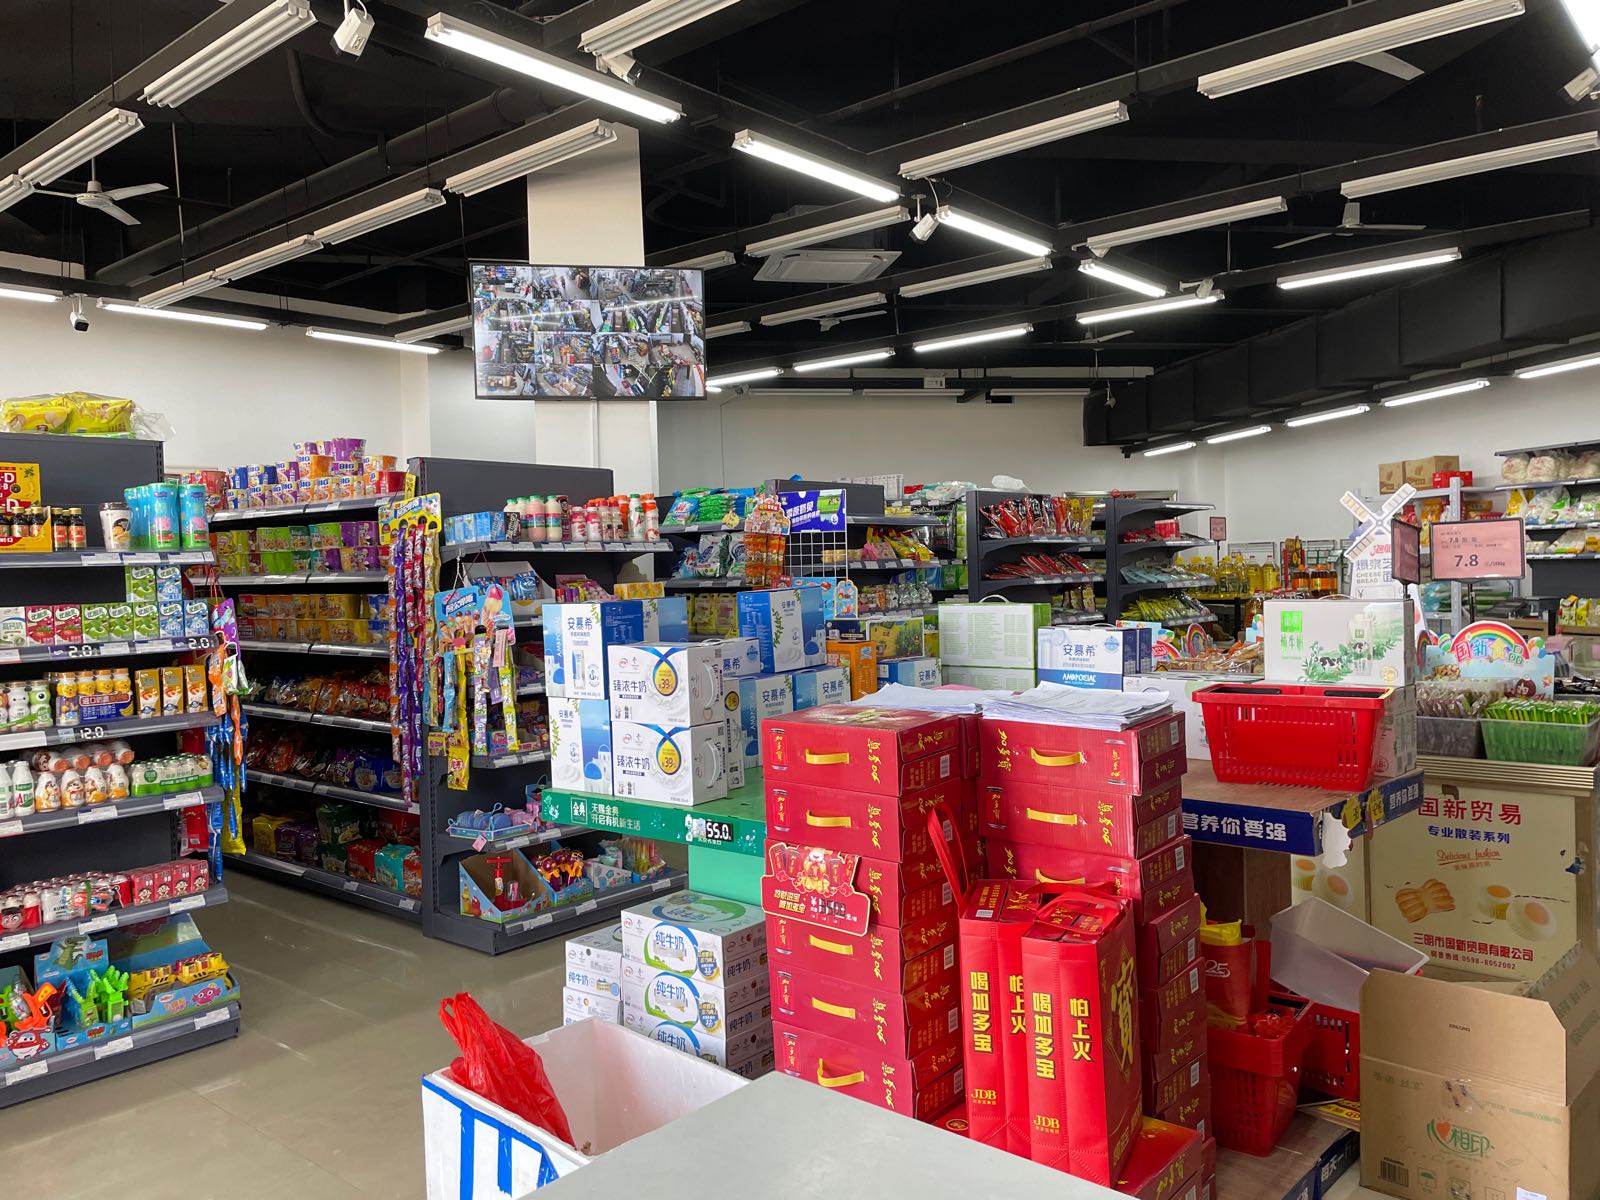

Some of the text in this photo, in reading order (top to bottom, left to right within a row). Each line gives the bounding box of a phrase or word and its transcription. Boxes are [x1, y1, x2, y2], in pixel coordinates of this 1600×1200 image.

[1454, 554, 1478, 567] 7.8
[567, 616, 593, 630] 安慕希
[68, 645, 93, 658] 2.0
[189, 637, 210, 650] 2.0
[1063, 644, 1096, 657] 安慕希
[722, 657, 741, 671] 慕希
[762, 687, 787, 703] 安慕希
[822, 680, 845, 694] 安慕希
[80, 727, 104, 740] 12.0
[573, 802, 586, 817] 金典
[591, 802, 619, 816] 天赐金典
[1418, 797, 1522, 826] 国新贸易
[591, 814, 641, 831] 开启有机新生活
[1182, 812, 1288, 842] 营养你要强
[706, 823, 731, 840] 55.0
[1427, 825, 1511, 844] 专业散装系列
[1437, 849, 1471, 863] Delicious
[655, 931, 685, 951] 纯牛奶
[1413, 932, 1534, 962] 三明市国新贸易有限公司
[568, 971, 589, 987] 纯牛奶
[656, 980, 686, 1000] 纯牛奶
[970, 971, 993, 1053] 喝加多宝
[1009, 975, 1026, 1034] 怕上火
[1032, 992, 1055, 1079] 喝加多宝
[1069, 998, 1093, 1062] 怕上火
[657, 1030, 687, 1051] 纯牛奶
[971, 1088, 997, 1100] JDB
[1034, 1114, 1060, 1128] JDB
